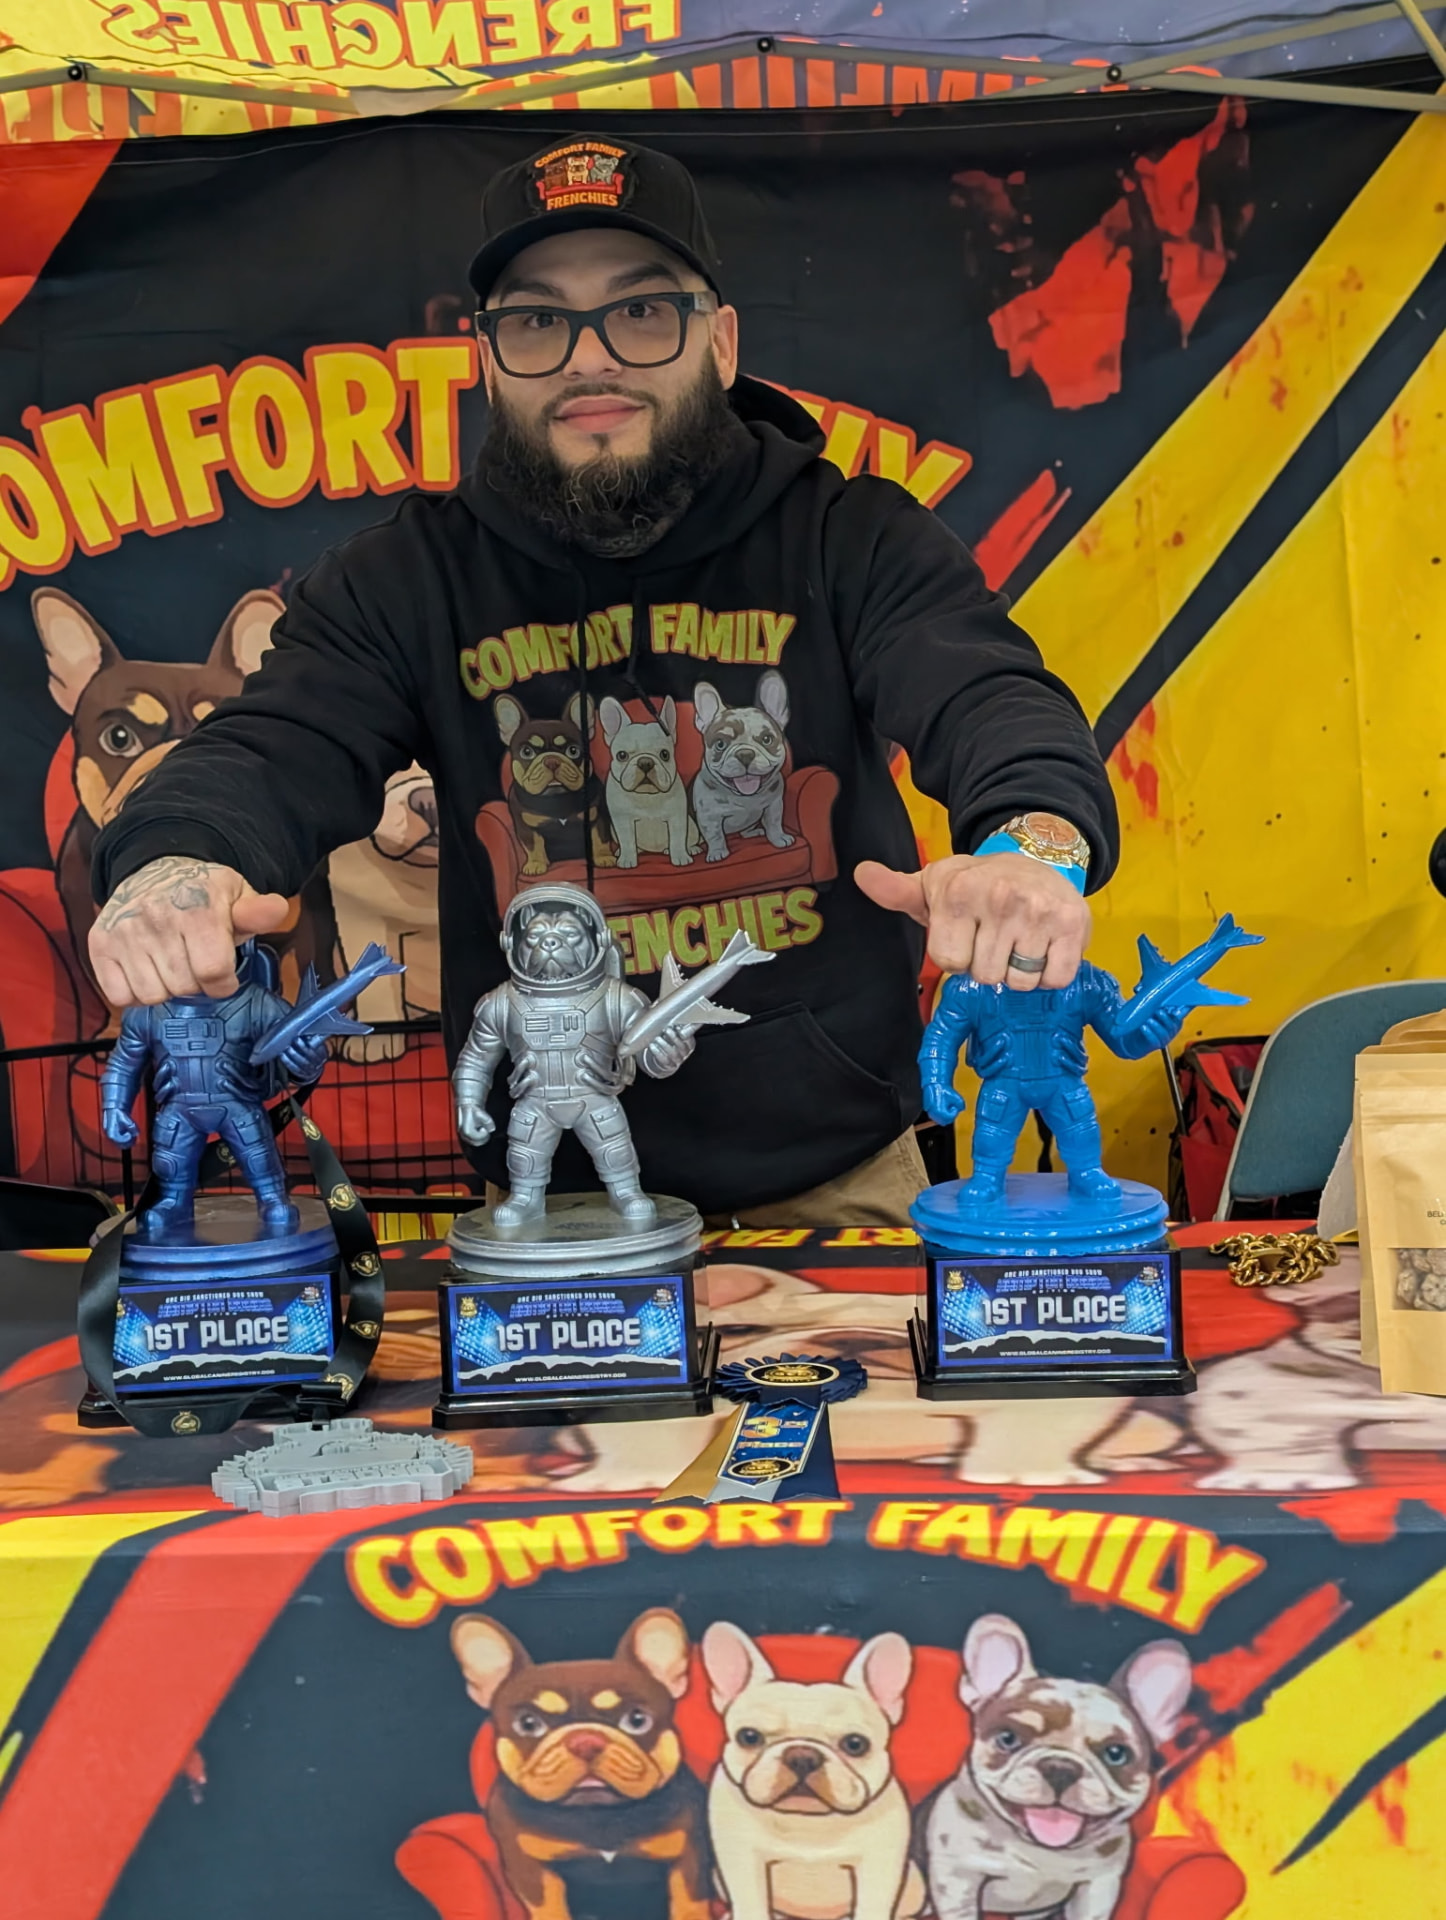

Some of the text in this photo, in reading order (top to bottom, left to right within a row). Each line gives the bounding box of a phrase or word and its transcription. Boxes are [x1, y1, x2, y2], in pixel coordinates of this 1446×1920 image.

[534, 142, 627, 168] COMFORT FAMILY
[546, 192, 618, 210] FRENCHIES
[0, 337, 478, 591] OMFORT
[460, 603, 796, 699] COMFORT FAMILY
[606, 887, 824, 975] ENCHIES
[982, 1295, 1126, 1326] 1ST PLACE
[144, 1316, 288, 1350] 1ST PLACE
[496, 1318, 641, 1352] 1ST PLACE
[346, 1501, 1265, 1632] COMFORT FAMILY
